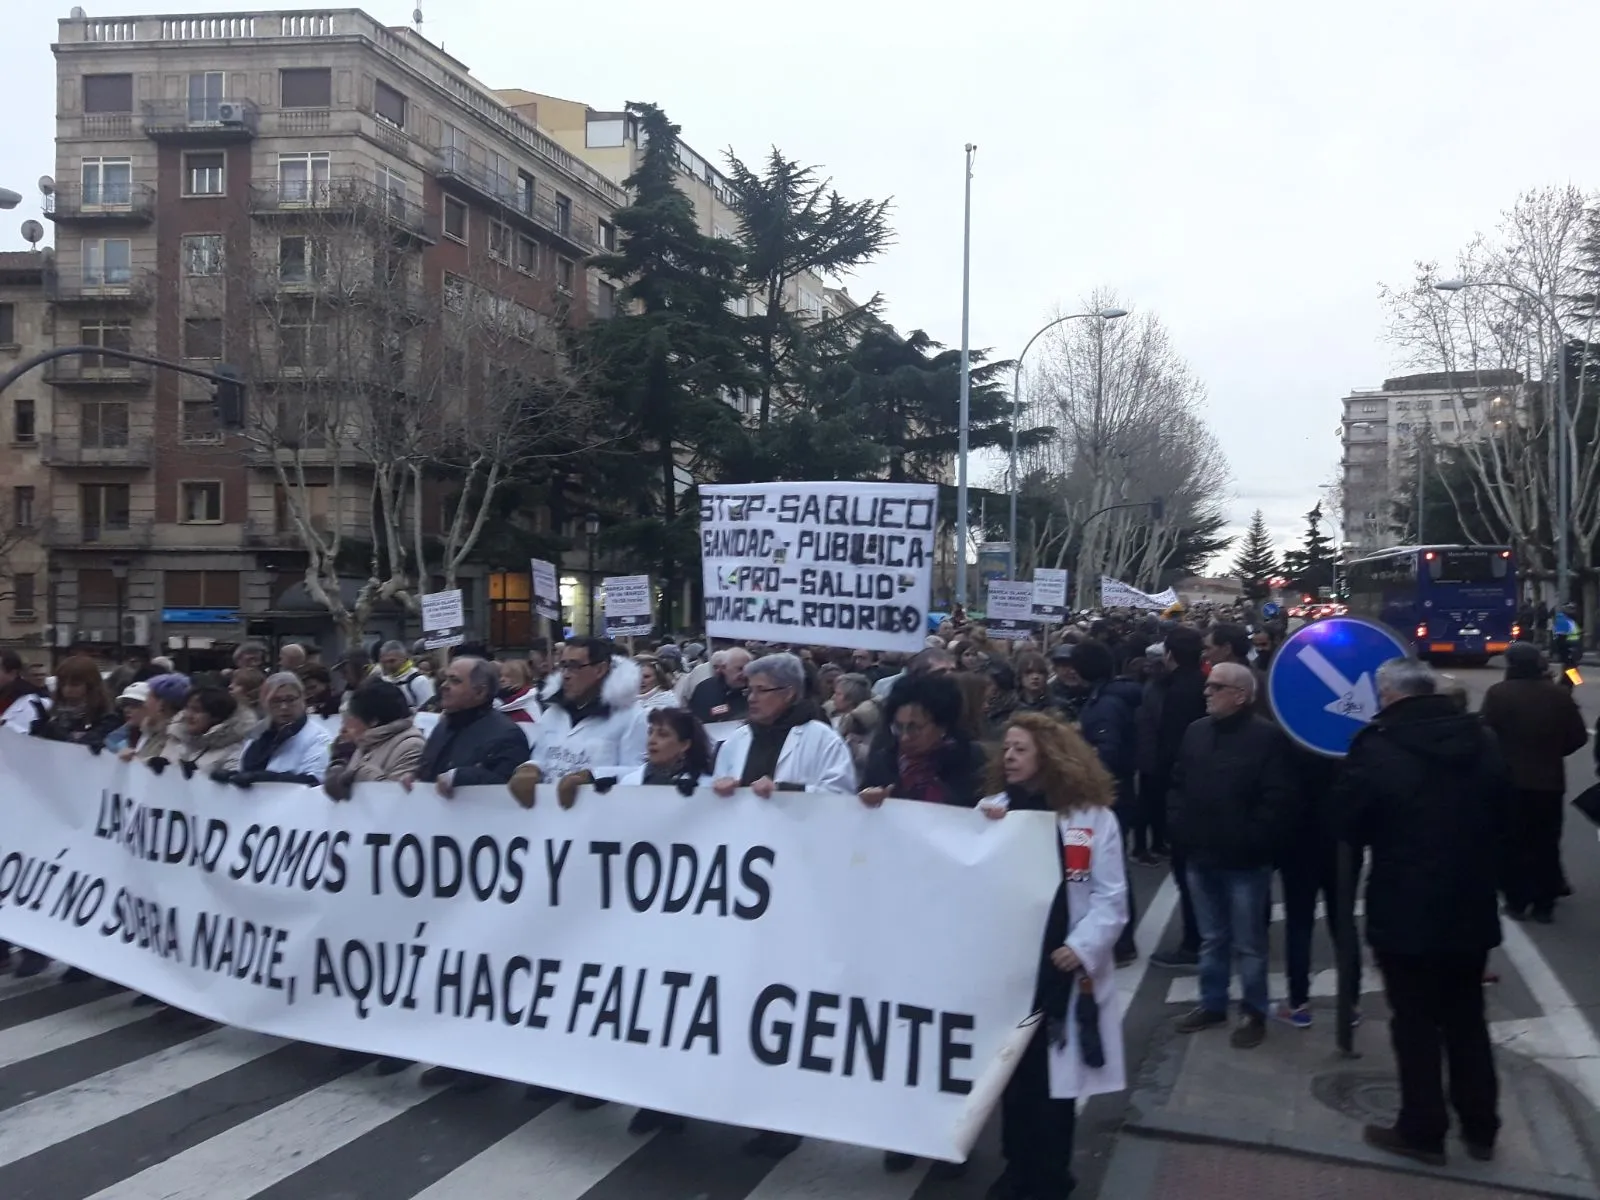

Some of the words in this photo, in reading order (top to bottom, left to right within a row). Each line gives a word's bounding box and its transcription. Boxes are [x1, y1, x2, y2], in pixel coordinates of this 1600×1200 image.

[122, 797, 229, 873] NIDAD
[227, 823, 351, 894] SOMOS
[363, 832, 529, 904] TODOS
[545, 838, 573, 908] Y
[589, 840, 776, 921] TODAS
[0, 847, 70, 912] QUÍ
[48, 870, 105, 927] NO
[312, 921, 430, 1020] AQUÍ
[434, 948, 562, 1029] HACE
[566, 963, 720, 1056] FALTA
[748, 983, 977, 1096] GENTE
